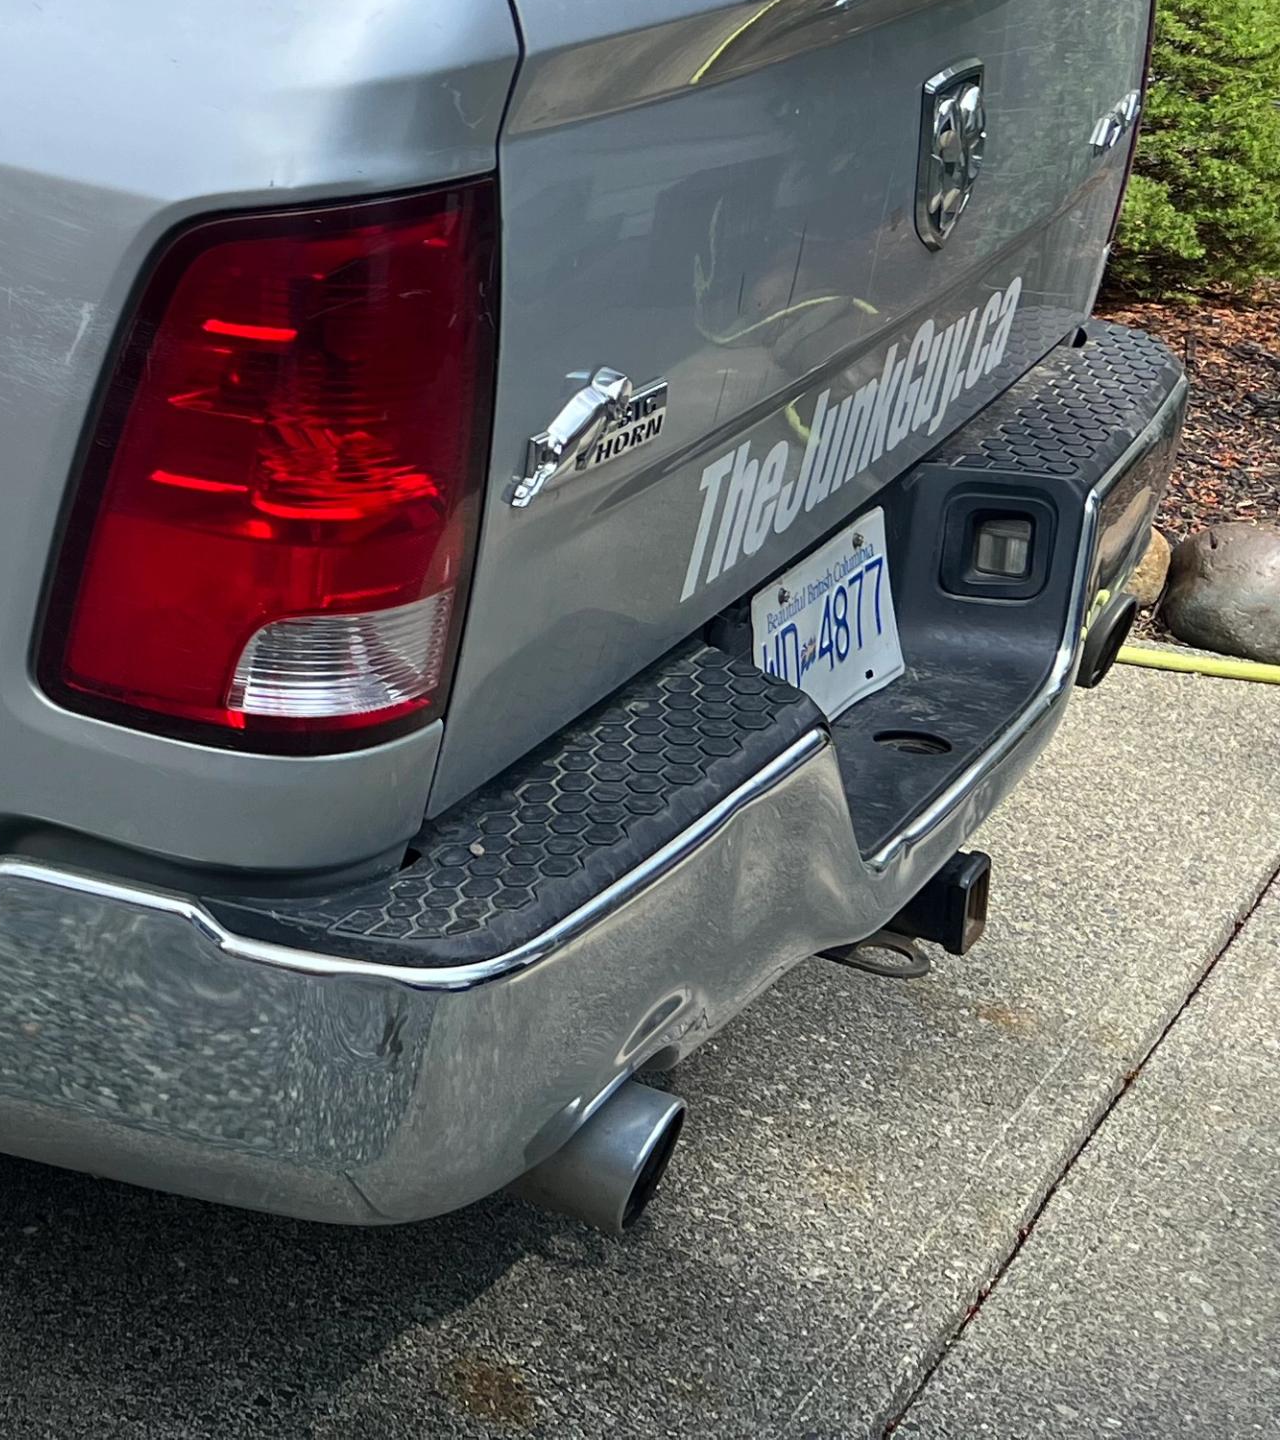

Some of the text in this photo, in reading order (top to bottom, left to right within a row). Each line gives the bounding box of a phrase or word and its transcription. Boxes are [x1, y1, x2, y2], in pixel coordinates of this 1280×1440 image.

[595, 415, 663, 464] HORN
[679, 277, 1023, 603] TheJunkGuy.ca
[767, 544, 874, 633] Beautiful British Columbia
[818, 557, 883, 671] 4877
